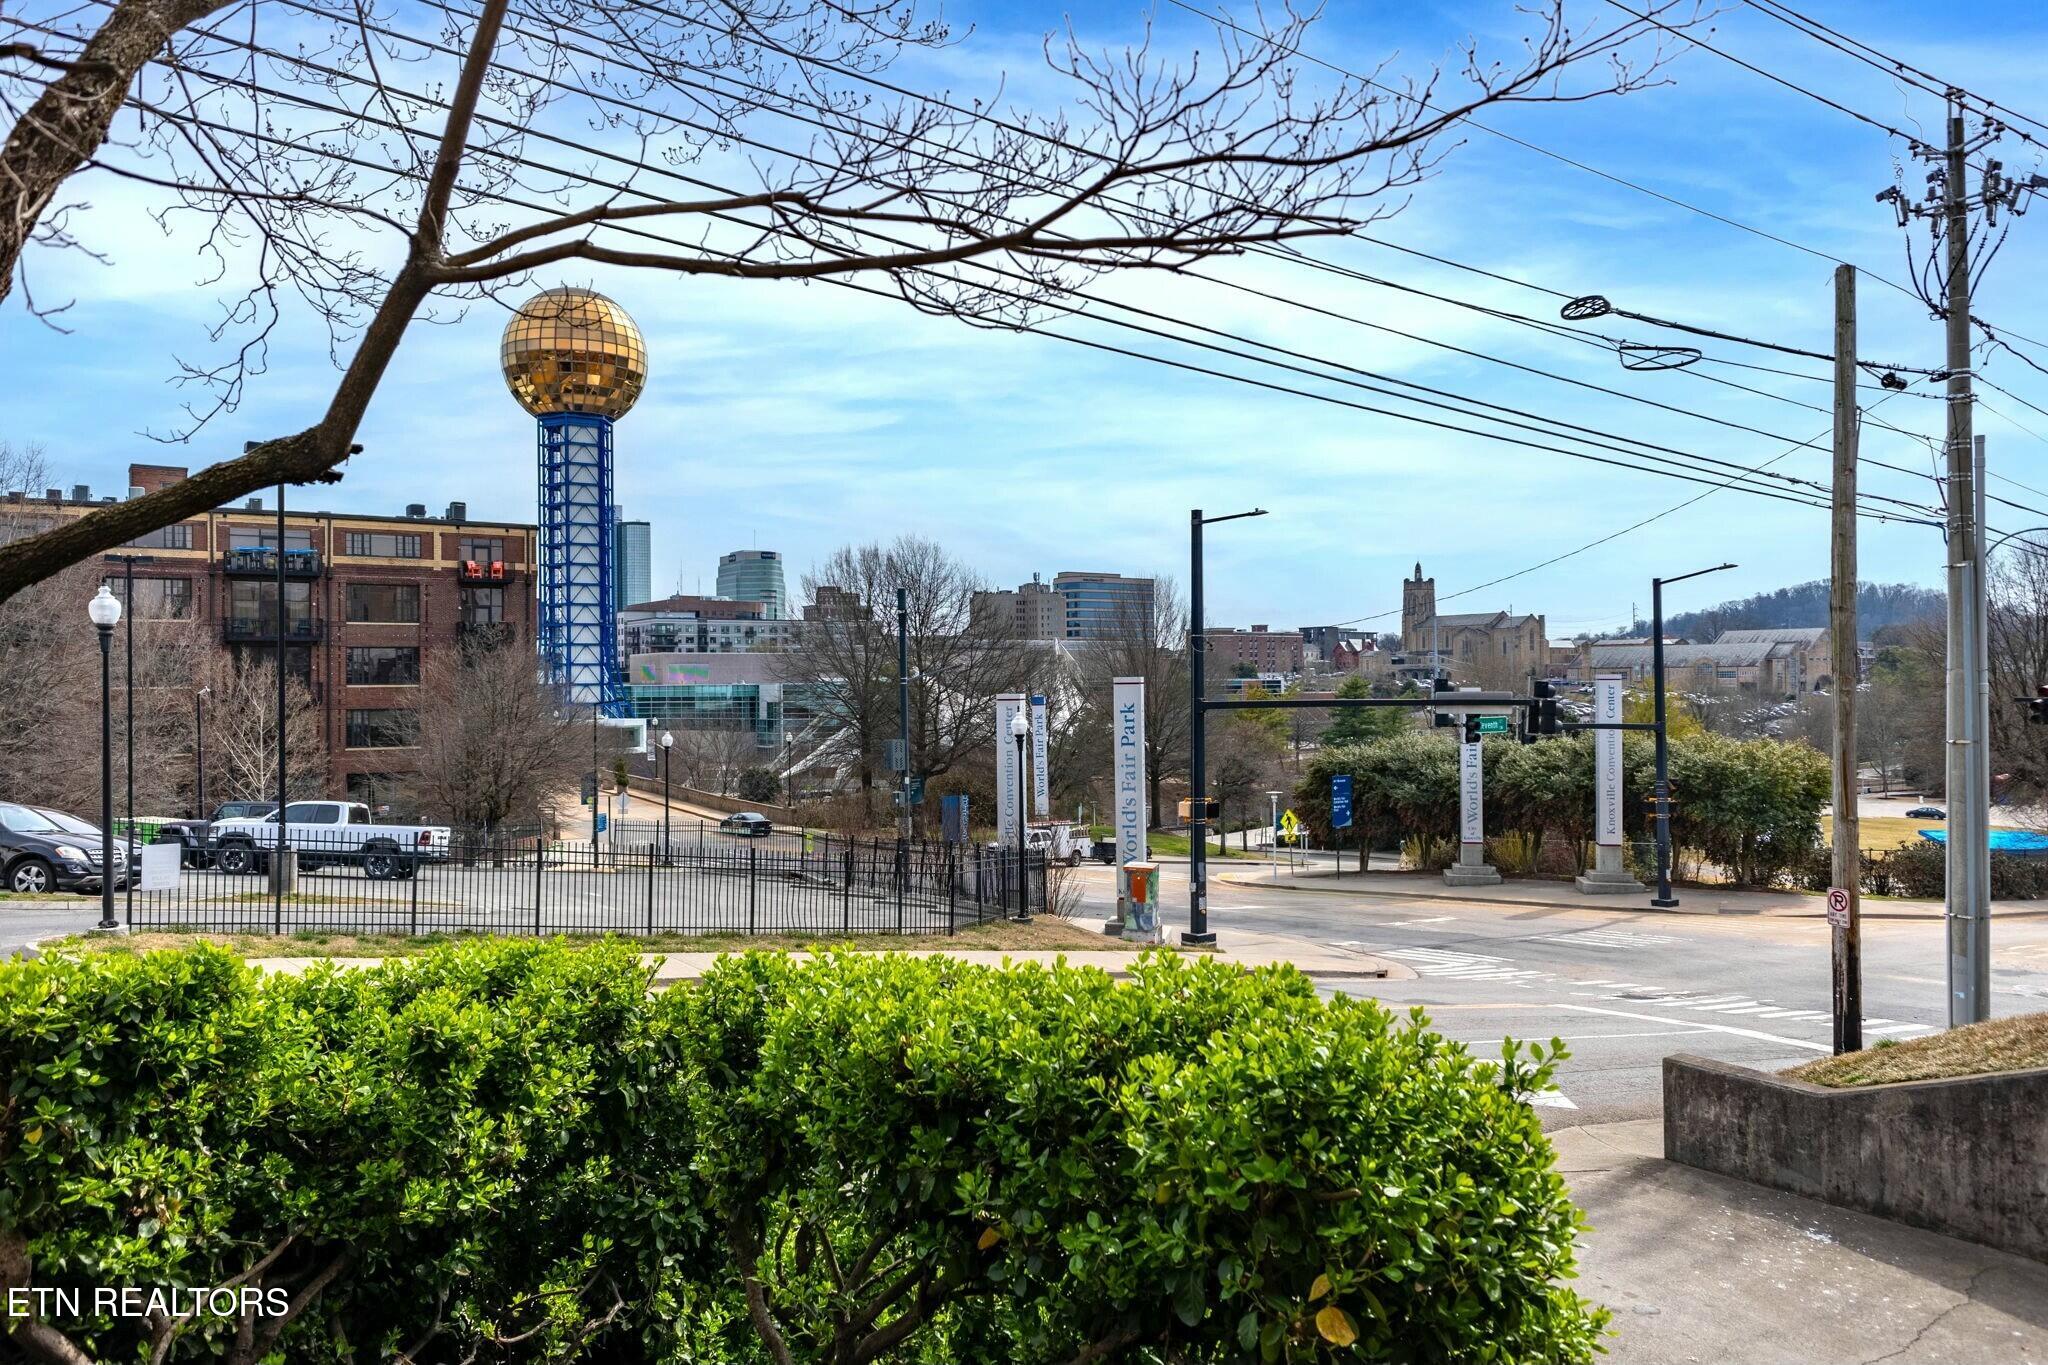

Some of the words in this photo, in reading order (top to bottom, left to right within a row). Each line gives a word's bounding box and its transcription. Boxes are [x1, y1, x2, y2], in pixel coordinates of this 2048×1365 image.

[1606, 684, 1615, 719] Center
[1004, 706, 1013, 745] Center
[1035, 713, 1043, 735] Park
[1119, 703, 1135, 748] Park
[1481, 721, 1498, 730] eventh
[1035, 736, 1044, 760] Fair
[1606, 729, 1616, 781] Conventio
[1004, 751, 1014, 817] Convention
[1036, 761, 1045, 798] World's
[1121, 754, 1136, 793] Fair
[1466, 772, 1479, 824] World's
[1606, 784, 1616, 835] Knoxville
